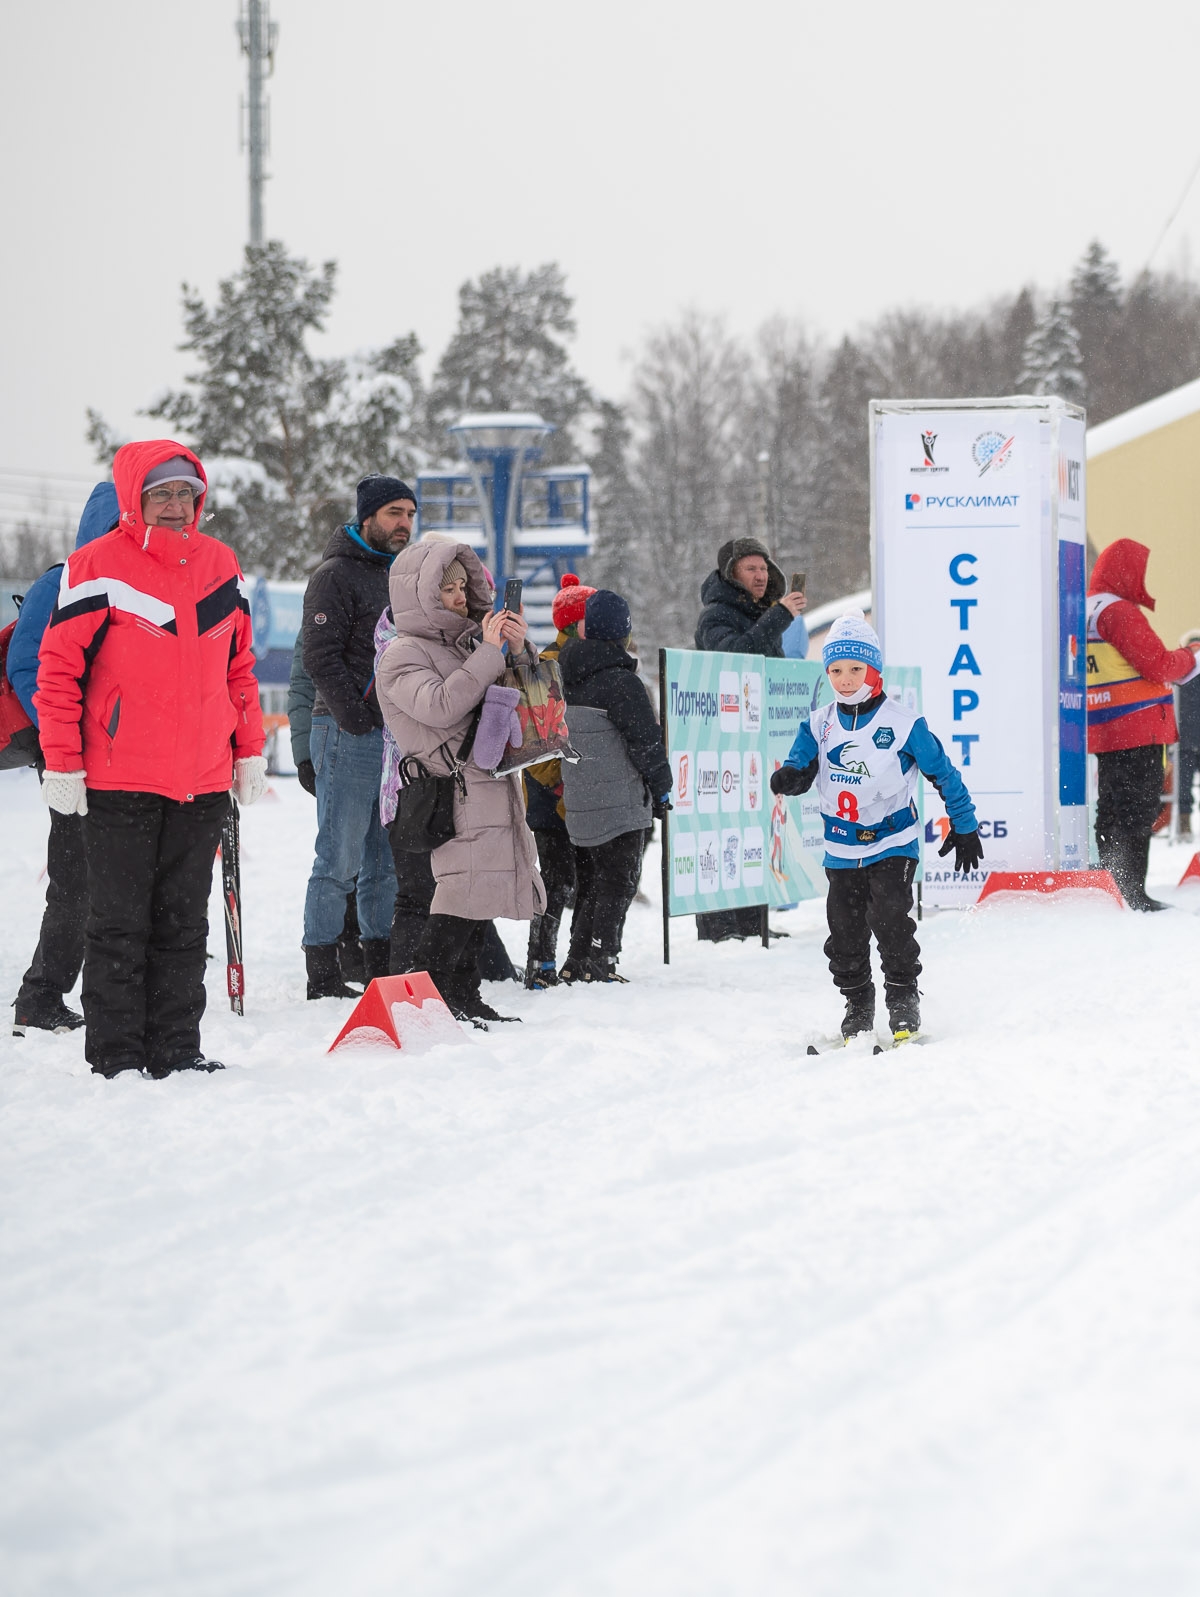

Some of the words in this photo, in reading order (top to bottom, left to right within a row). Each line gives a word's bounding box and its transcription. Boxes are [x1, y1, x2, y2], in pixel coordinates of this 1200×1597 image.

[926, 495, 1020, 508] РУСКЛИМАТ
[828, 645, 873, 658] РОССИИ
[948, 553, 982, 767] СТАРТ
[671, 681, 719, 726] Партнеры
[830, 773, 863, 785] СТРИЖ
[836, 790, 860, 823] 8
[976, 820, 1008, 839] СБ
